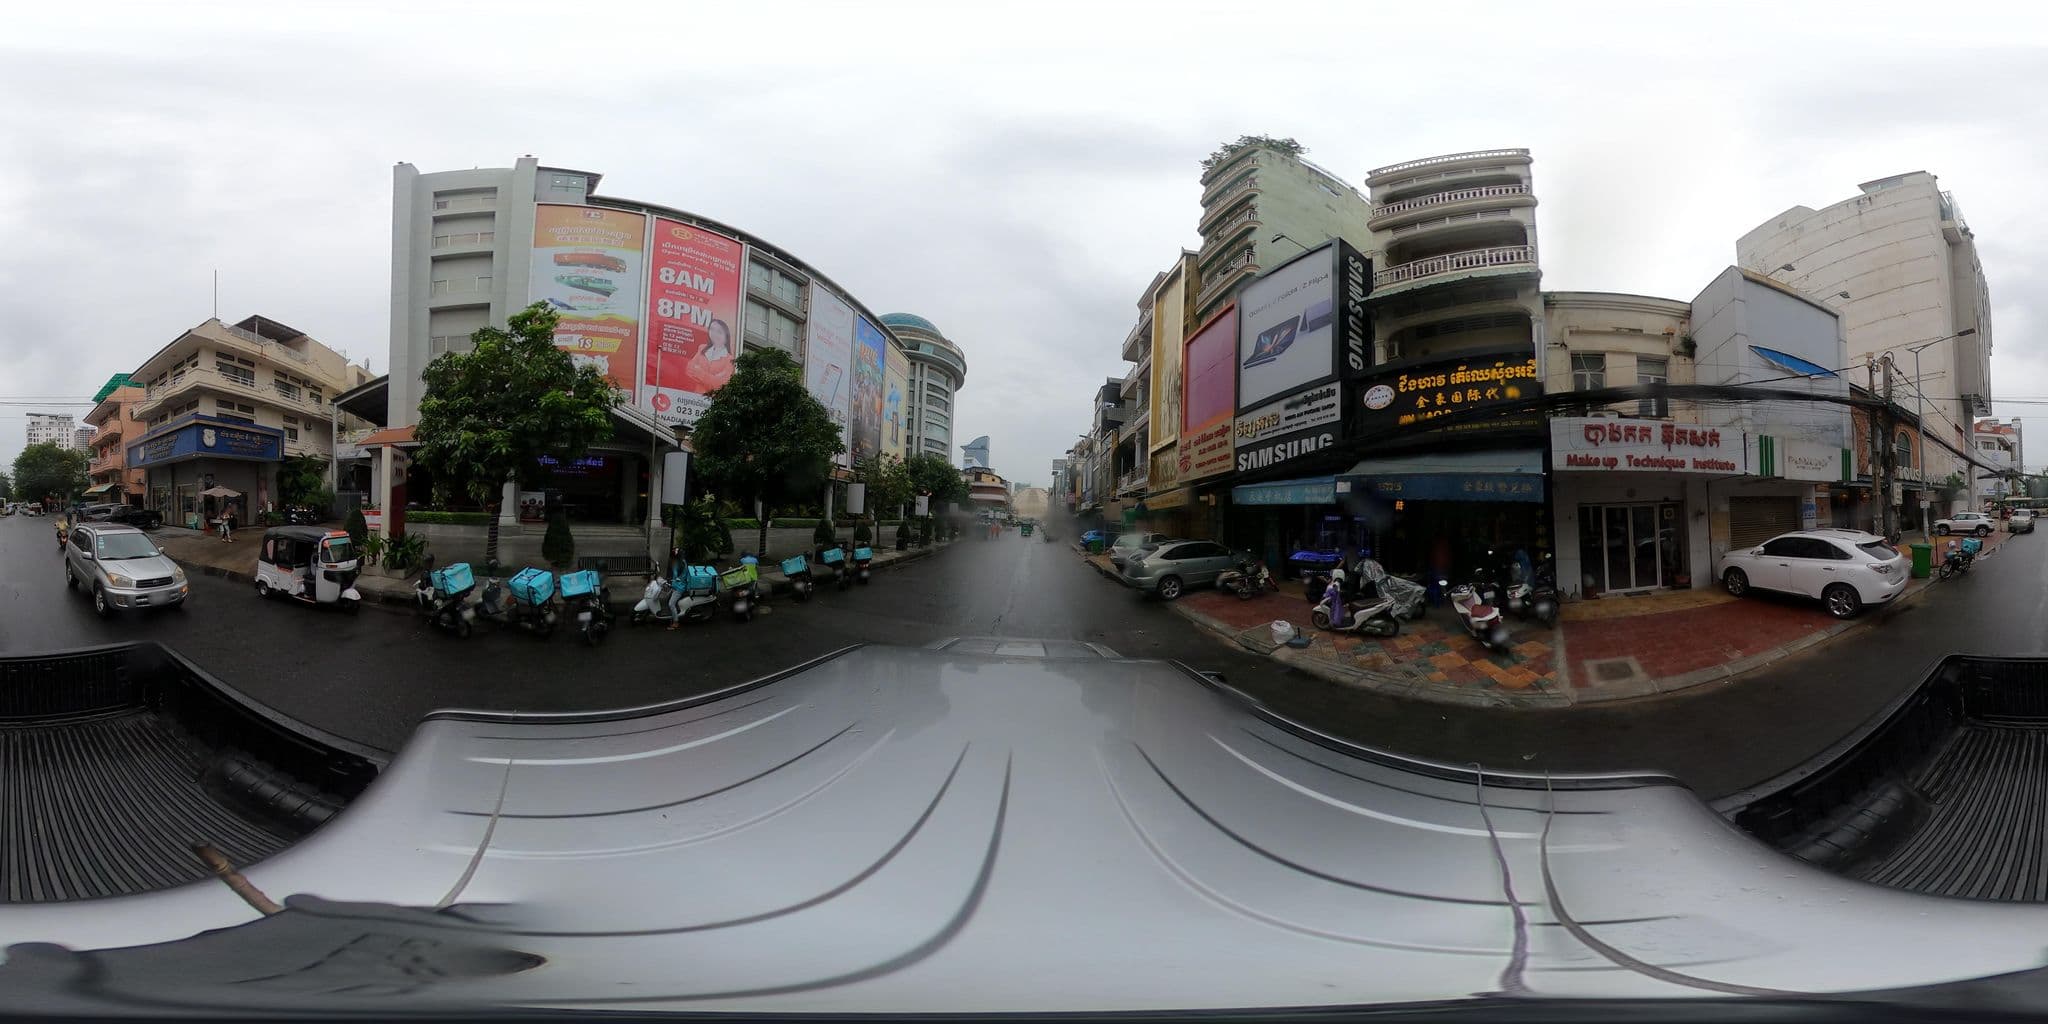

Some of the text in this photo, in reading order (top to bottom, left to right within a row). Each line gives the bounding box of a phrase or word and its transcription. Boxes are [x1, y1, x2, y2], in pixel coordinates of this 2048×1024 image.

[659, 266, 715, 296] 8AM
[657, 298, 713, 328] 8PM
[1348, 255, 1363, 371] SAMSUNG
[676, 406, 693, 417] 023
[1238, 433, 1334, 472] SAMSUNG
[1567, 454, 1736, 471] Make up Technique Institute
